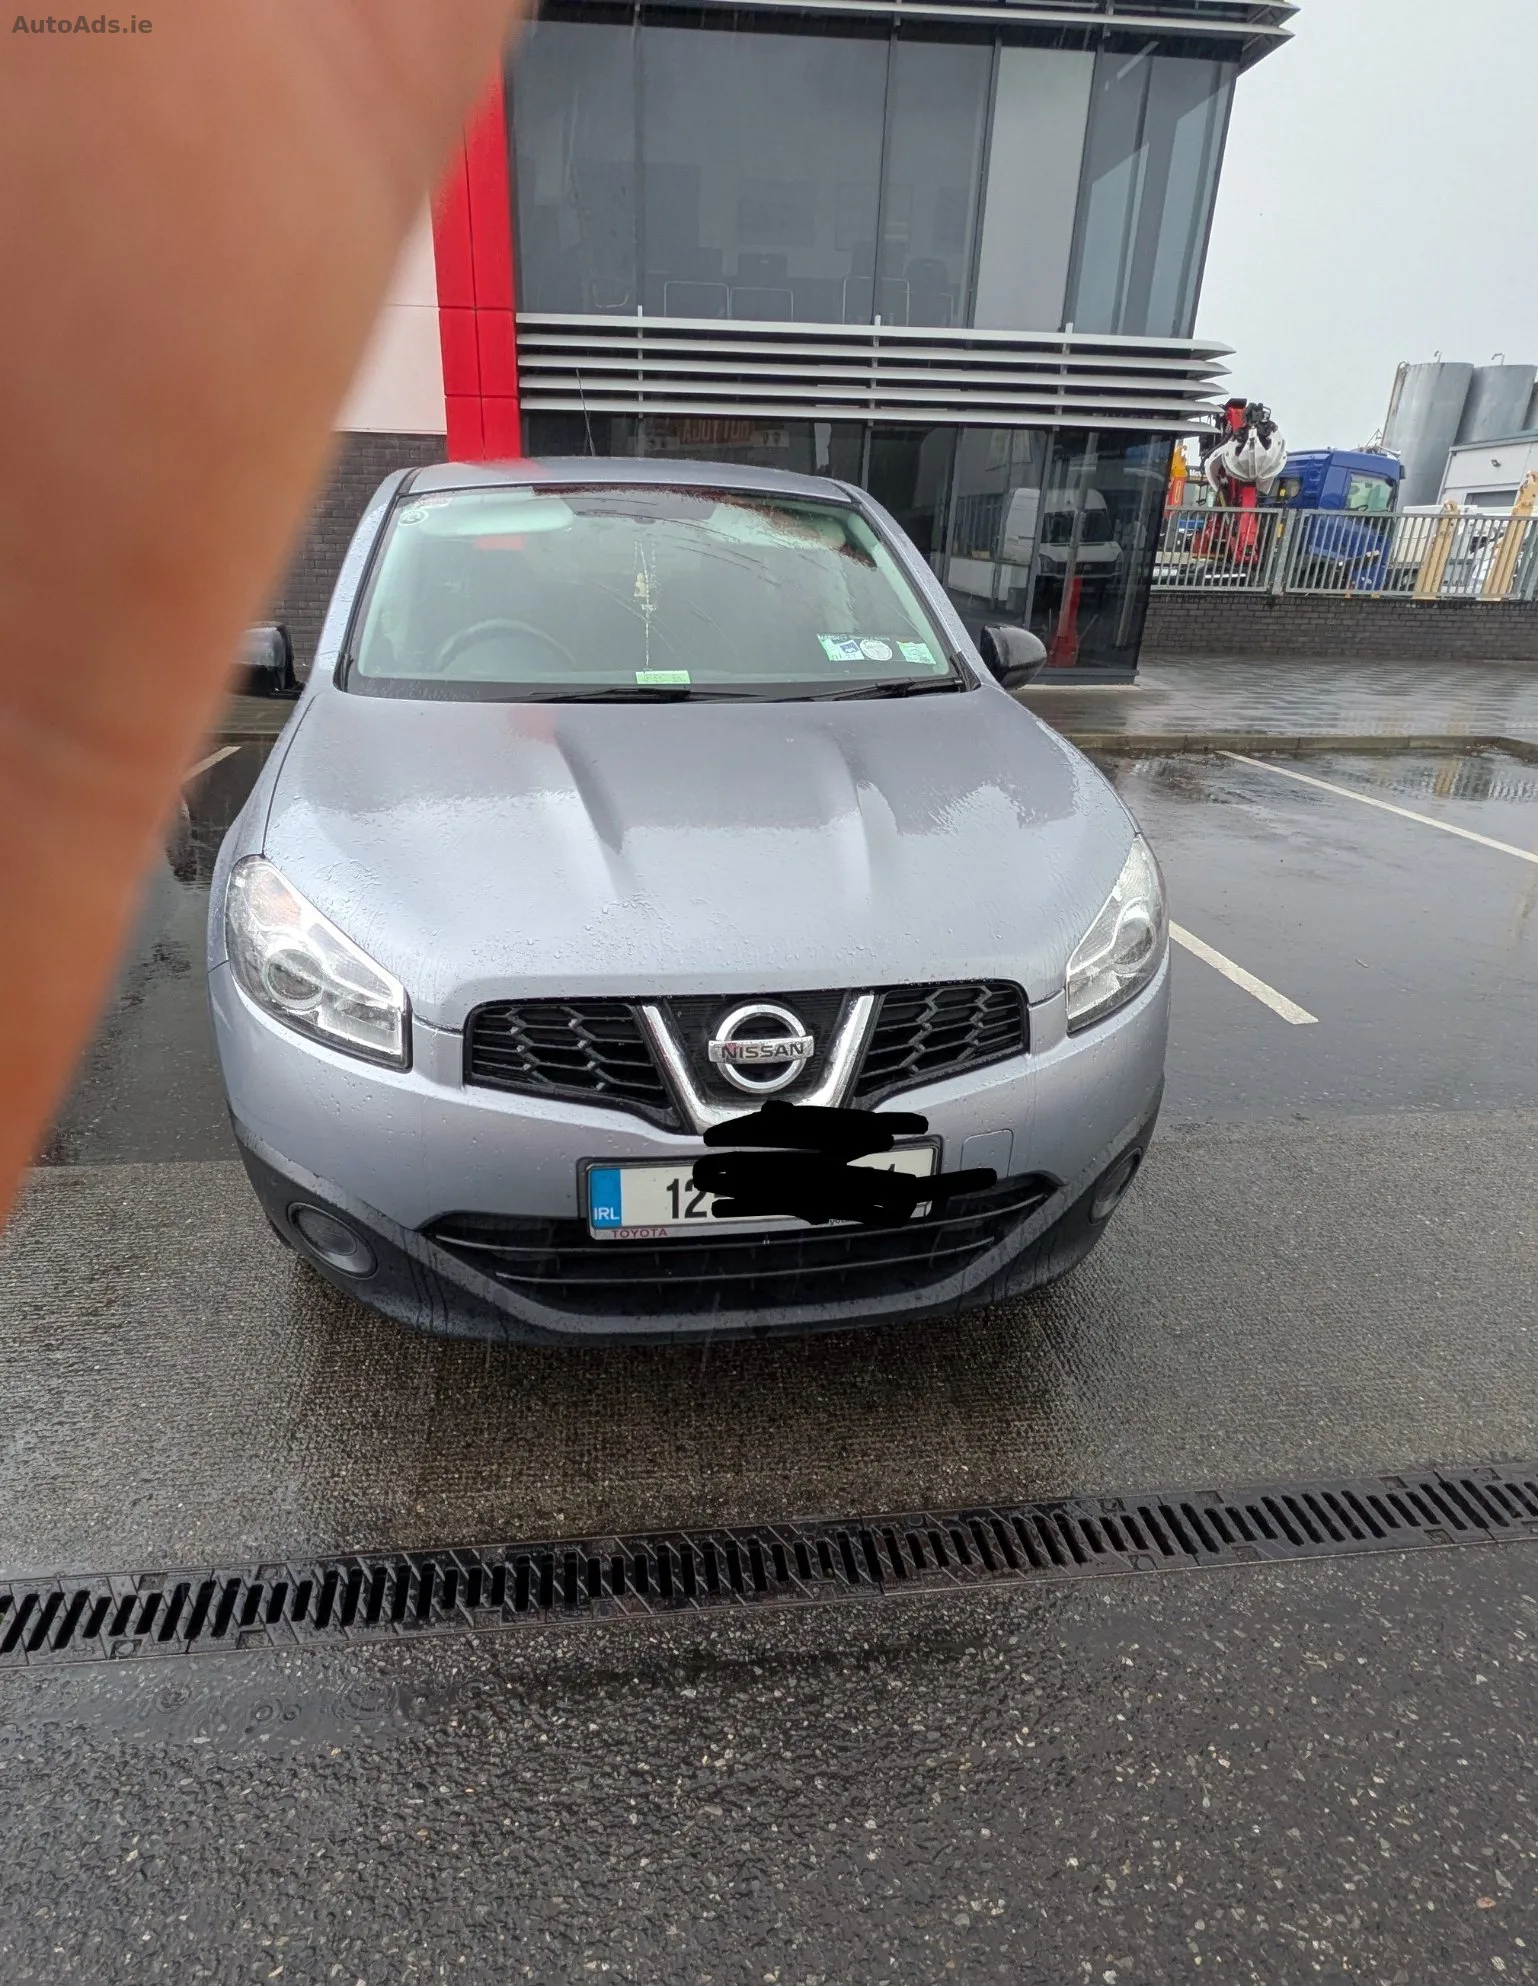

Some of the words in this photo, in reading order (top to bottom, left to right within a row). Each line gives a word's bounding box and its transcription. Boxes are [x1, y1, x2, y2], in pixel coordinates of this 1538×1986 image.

[721, 1042, 804, 1059] NISSAN
[593, 1206, 620, 1221] IRL
[611, 1227, 669, 1240] TOYOTA
